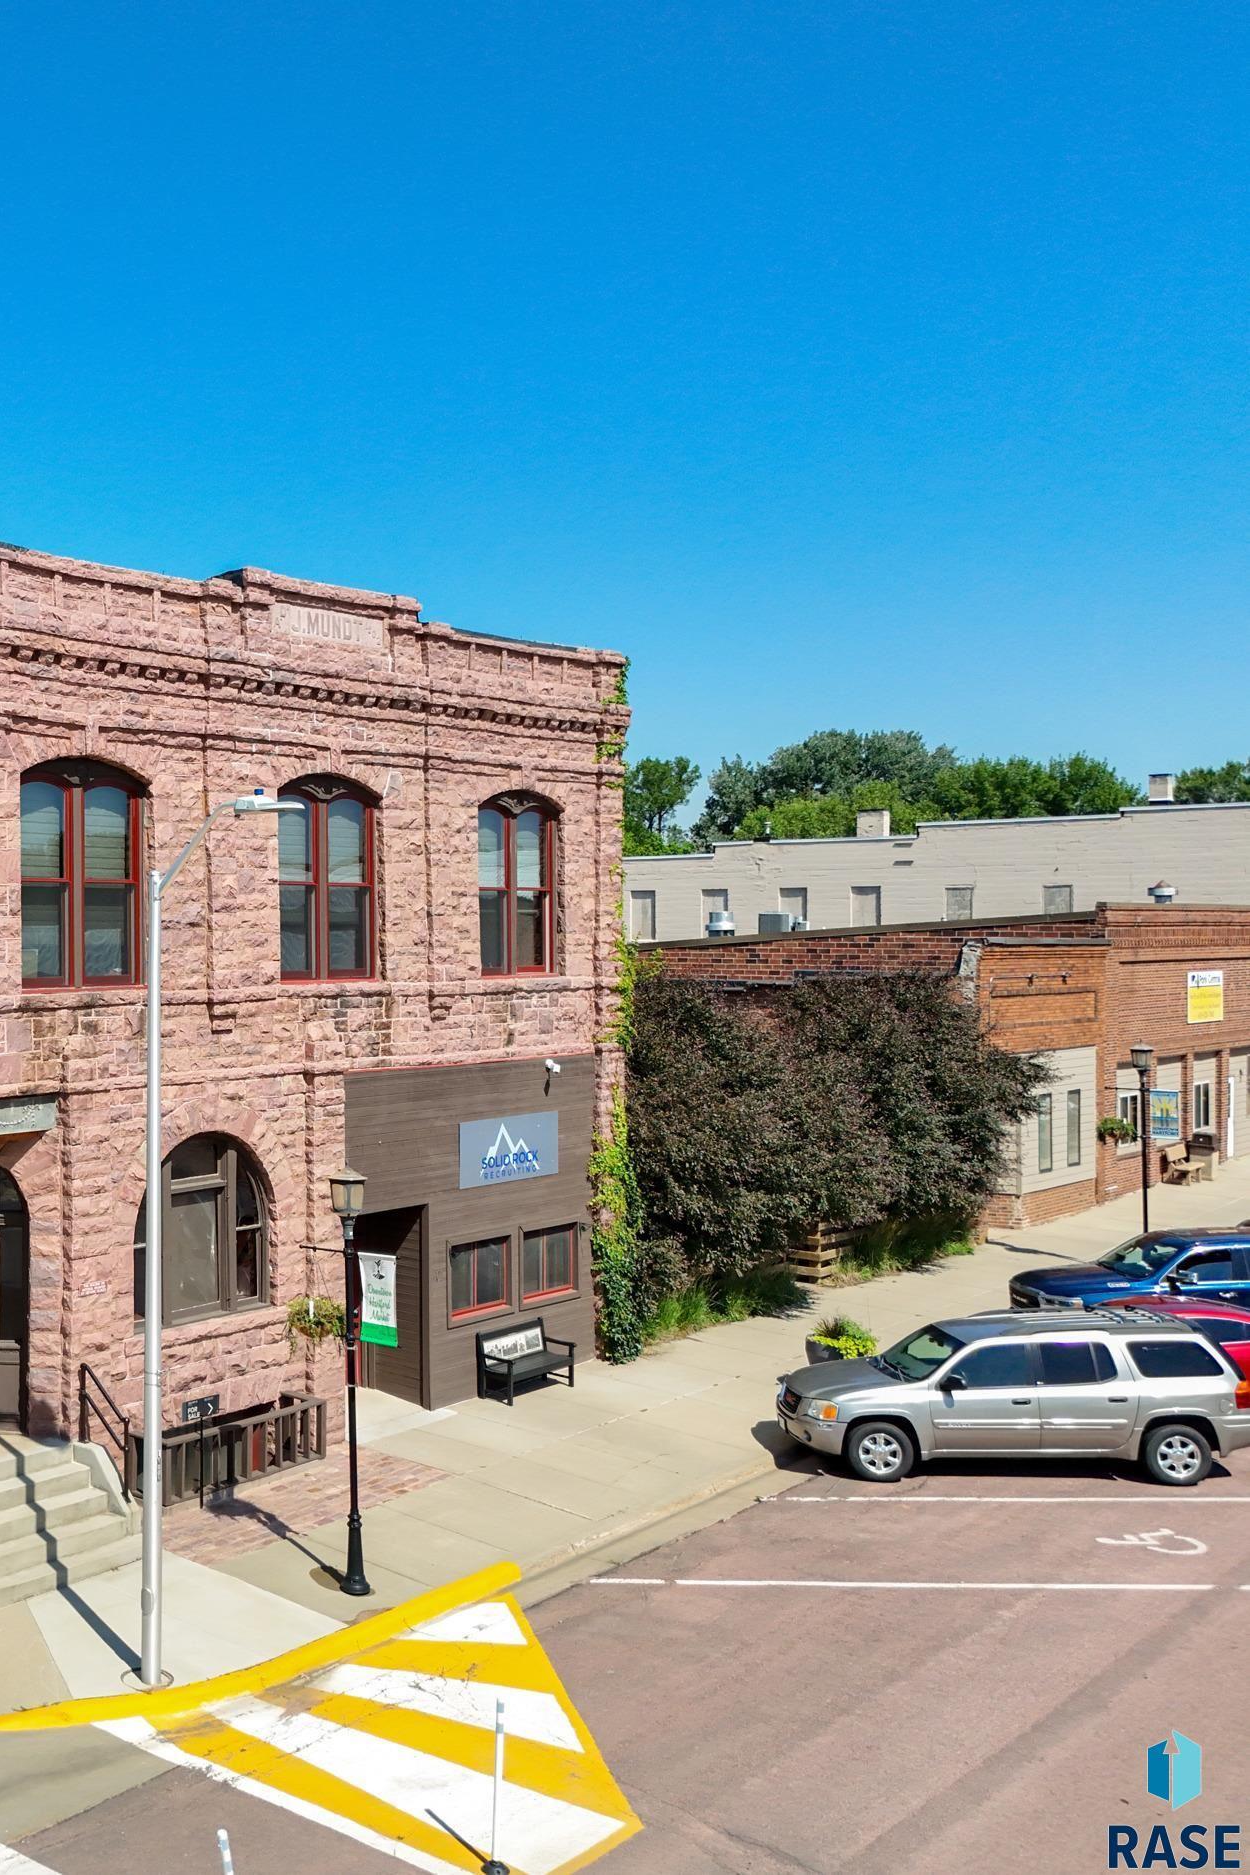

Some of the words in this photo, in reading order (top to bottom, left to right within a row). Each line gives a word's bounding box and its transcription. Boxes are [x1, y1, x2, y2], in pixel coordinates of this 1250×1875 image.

[481, 1154, 510, 1170] SOLID
[512, 1150, 539, 1166] ROCK
[483, 1164, 537, 1180] RECRUITING
[187, 1411, 201, 1419] SALE
